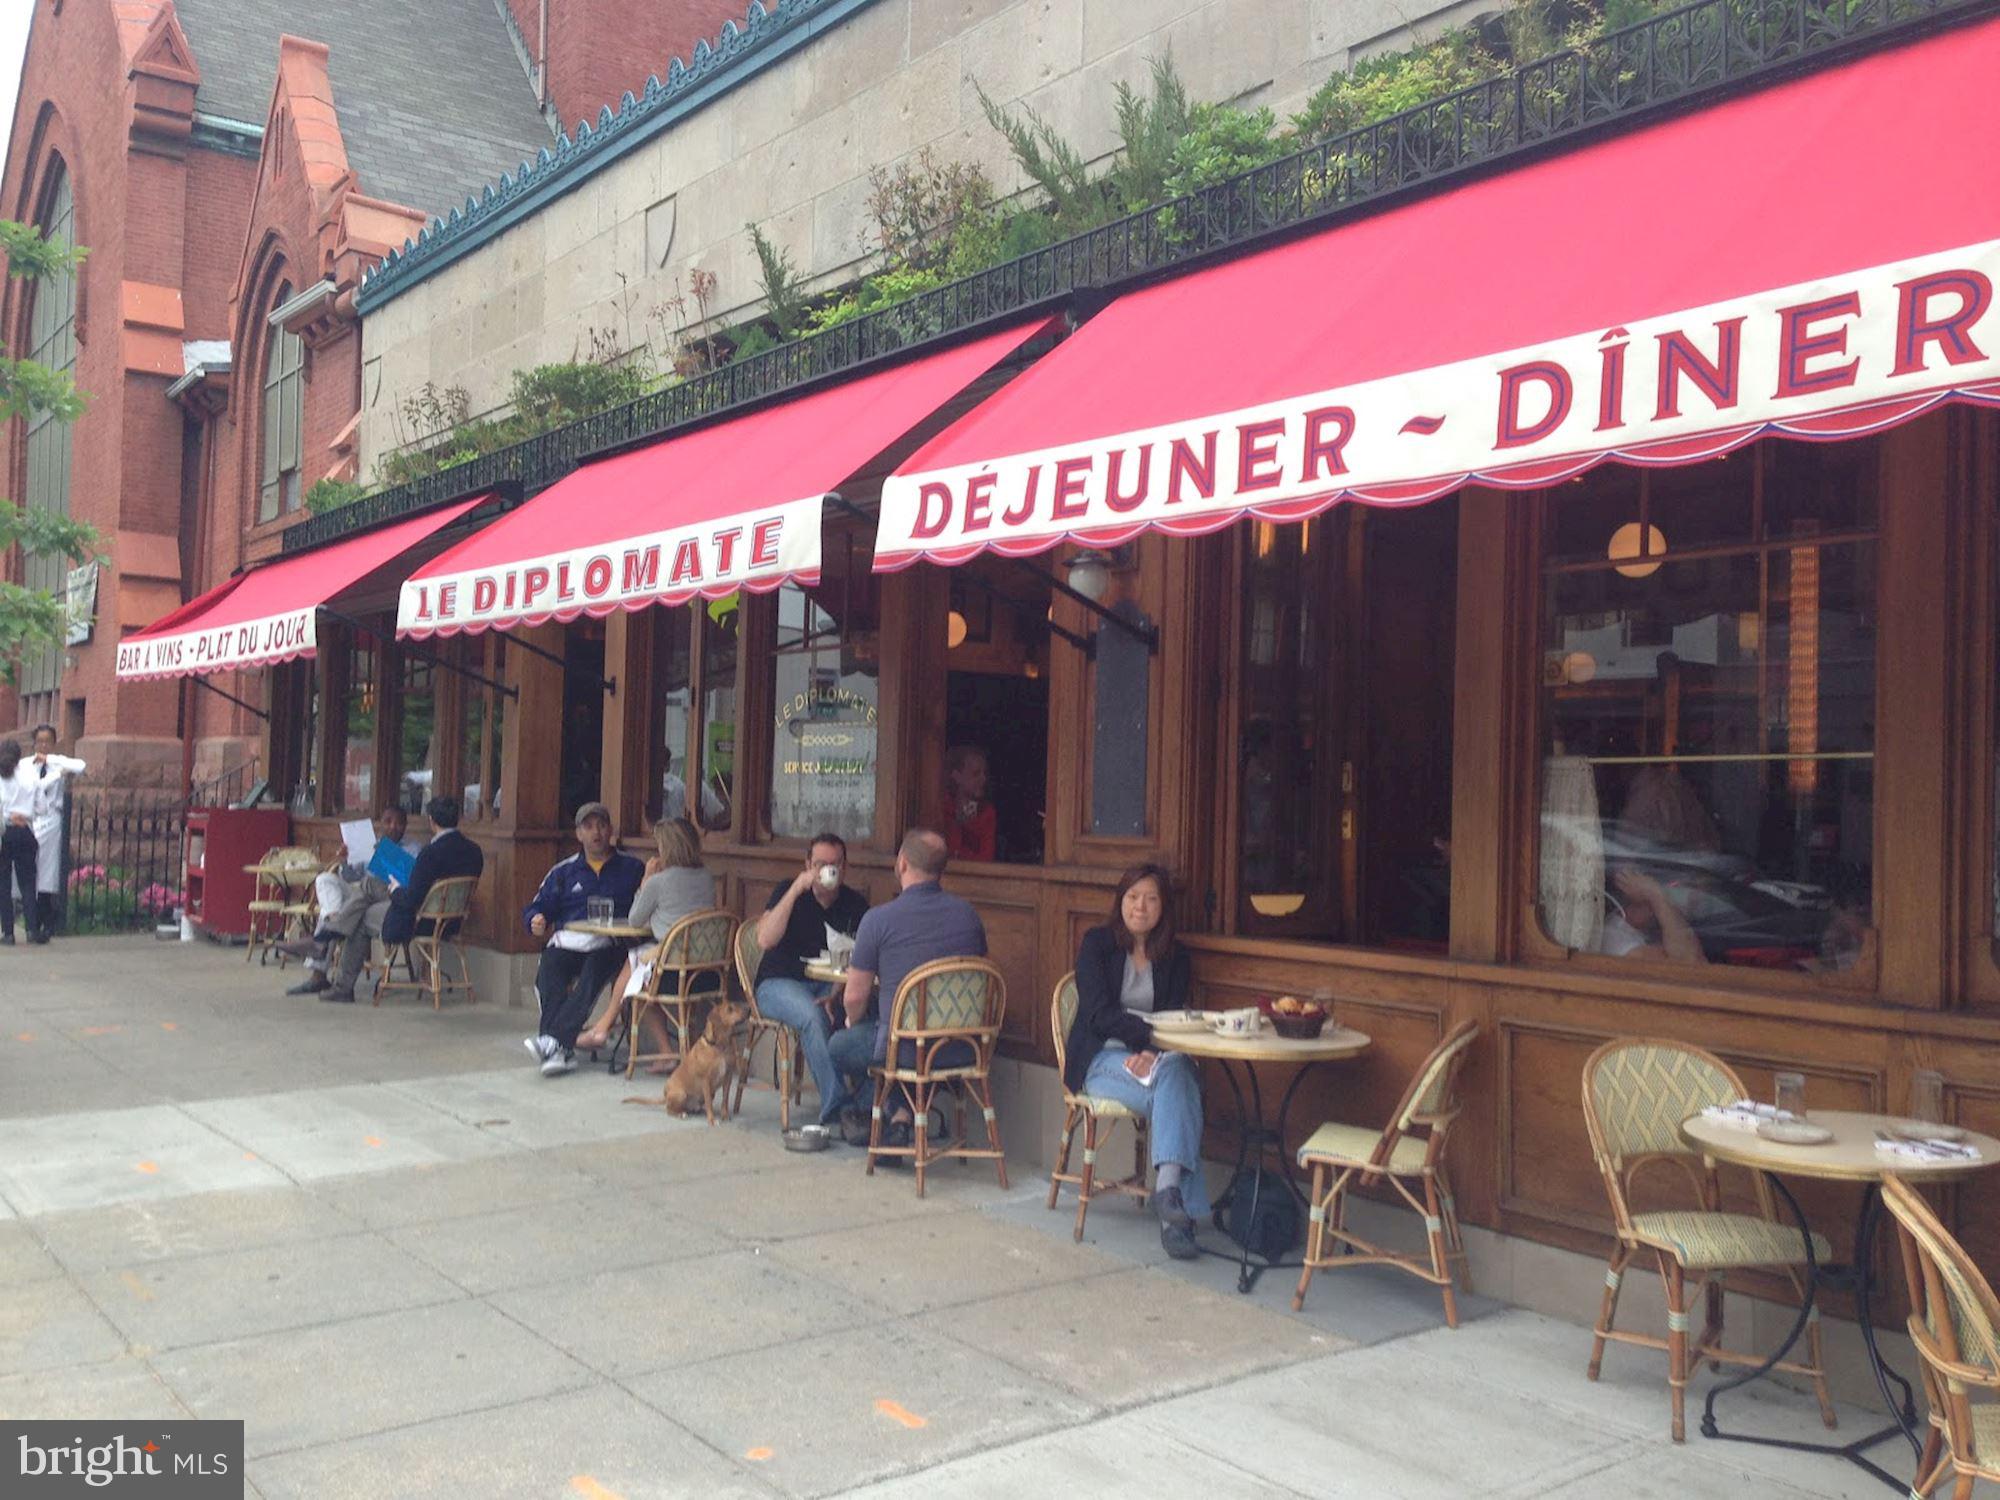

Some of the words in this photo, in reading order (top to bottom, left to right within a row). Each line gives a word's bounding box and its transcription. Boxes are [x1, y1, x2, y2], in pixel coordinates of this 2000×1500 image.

[908, 405, 1356, 539] DÉJEUNER
[1491, 266, 1995, 451] DÎNER
[415, 582, 457, 622] LE
[473, 515, 784, 615] DIPLOMATE
[118, 647, 141, 671] BAR
[157, 640, 183, 667] VINS
[196, 628, 232, 661] PLAT
[238, 622, 257, 656] DU
[264, 614, 307, 651] JOUR
[775, 703, 791, 728] LE
[795, 687, 877, 721] DIPLOMATE
